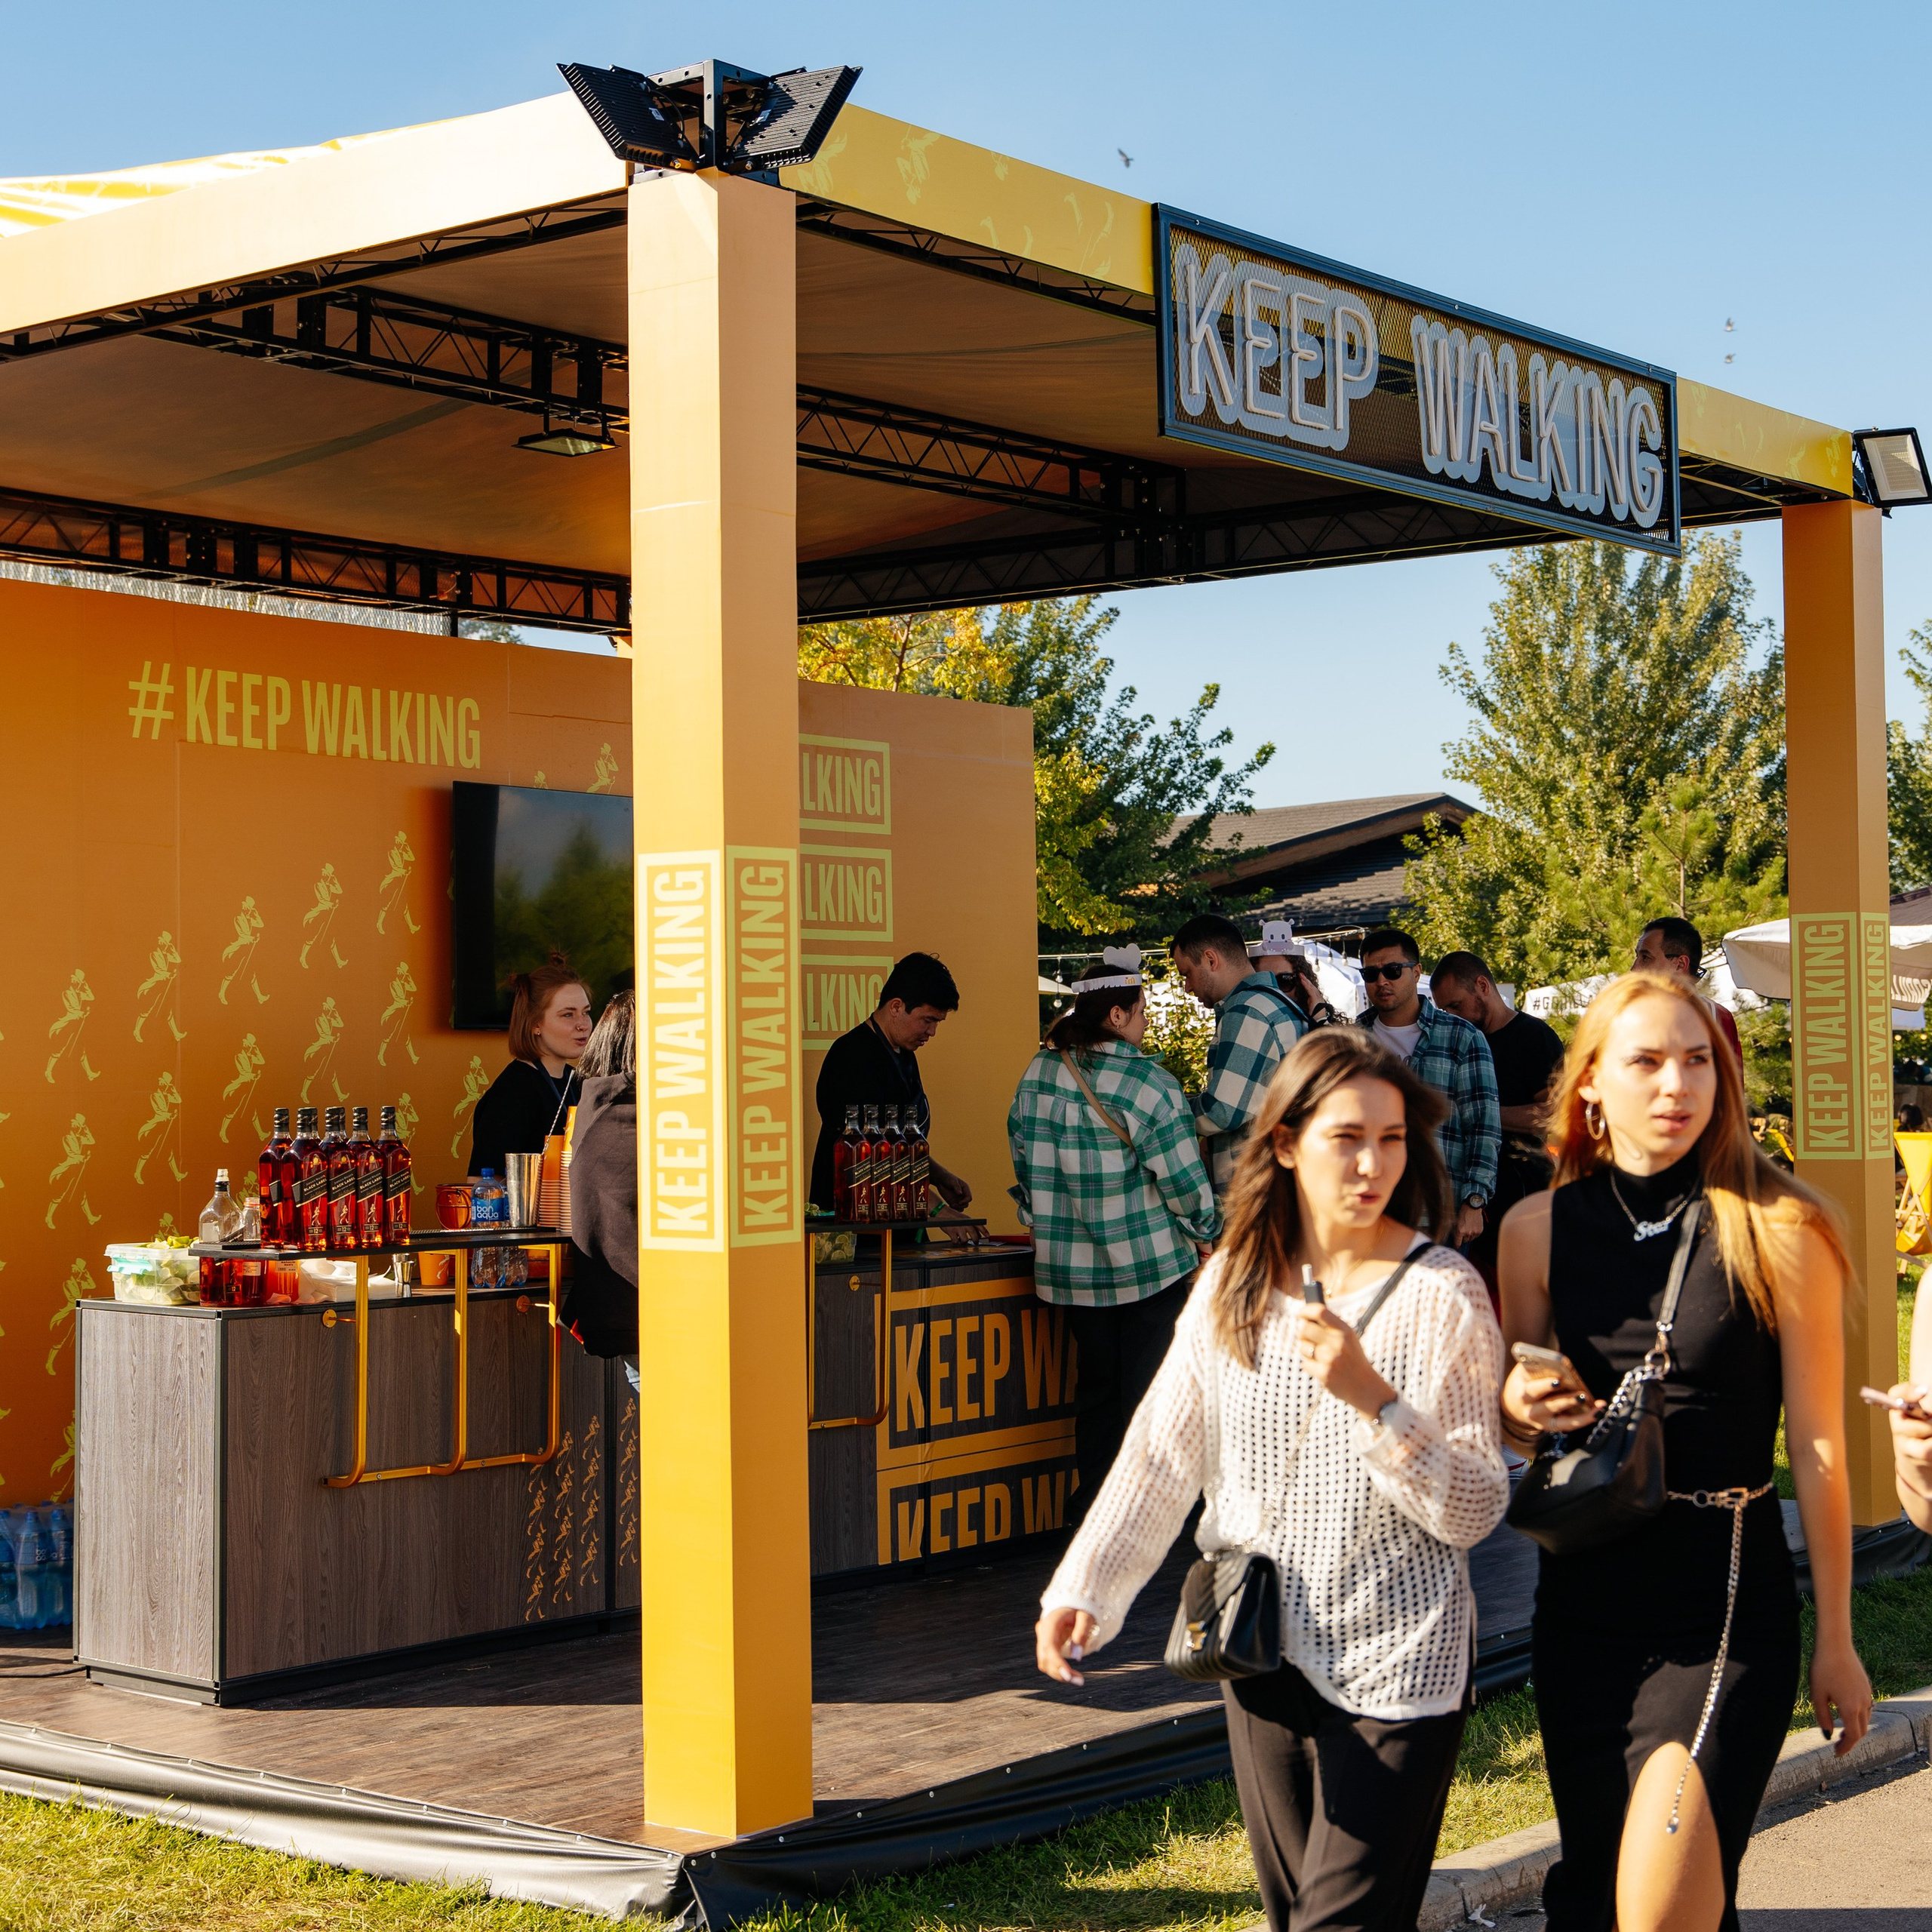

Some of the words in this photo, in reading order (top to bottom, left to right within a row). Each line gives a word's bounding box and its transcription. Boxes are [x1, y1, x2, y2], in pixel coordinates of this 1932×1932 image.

[1177, 245, 1377, 449] KEEP
[1411, 317, 1663, 526] WALKING
[303, 680, 481, 769] WALKING
[799, 752, 881, 816] LKING
[800, 863, 883, 924] LKING
[653, 869, 706, 1099] WALKING
[740, 866, 786, 1094] WALKING
[802, 973, 883, 1031] LKING
[1804, 924, 1847, 1066] WALKING
[1866, 924, 1887, 1065] WALKING
[743, 1105, 788, 1226] KEEP
[1807, 1072, 1849, 1147] KEEP
[1869, 1072, 1888, 1147] KEEP
[656, 1111, 708, 1232] KEEP
[895, 1312, 1011, 1432] KEEP
